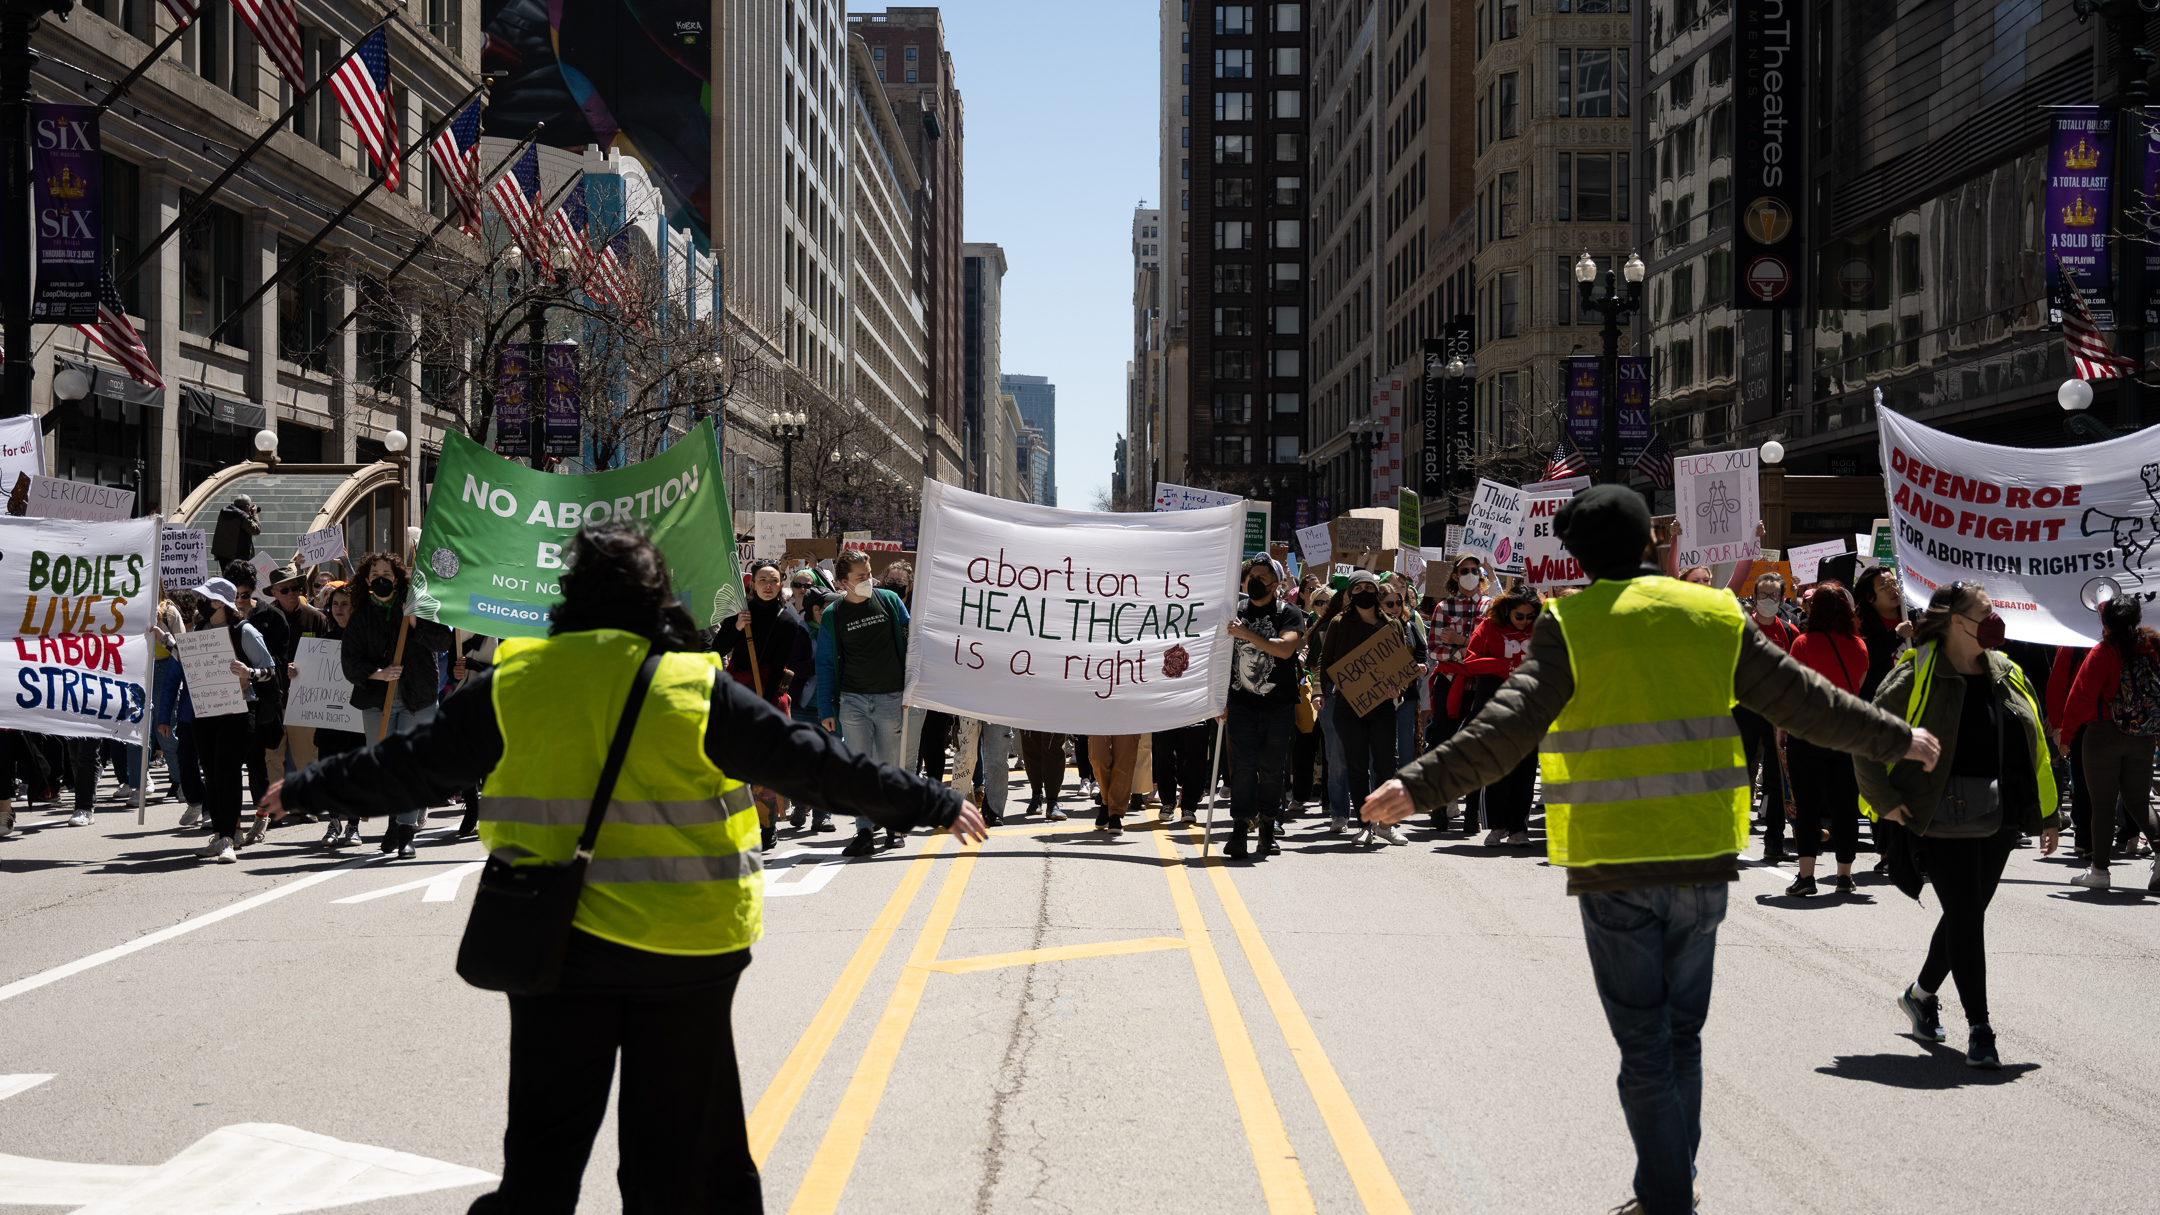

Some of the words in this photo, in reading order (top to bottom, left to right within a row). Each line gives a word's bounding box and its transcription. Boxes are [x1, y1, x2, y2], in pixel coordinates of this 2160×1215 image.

[676, 20, 703, 31] KOBRA
[2059, 176, 2080, 188] TOTAL
[2060, 233, 2087, 248] SOLID
[2074, 256, 2095, 265] PLAYING
[42, 290, 92, 299] LoopChicago.com
[1747, 324, 1769, 352] BLOCK
[1747, 351, 1769, 376] THIRTY
[1747, 377, 1767, 402] SEVEN
[2, 445, 18, 457] for
[1425, 442, 1440, 483] rack
[1680, 456, 1717, 477] FUCK
[1725, 451, 1751, 470] YOU
[1891, 446, 2002, 505] DEFEND
[2005, 484, 2083, 509] ROE
[38, 480, 131, 508] SERIOUSLY?
[461, 473, 518, 518] NO
[525, 464, 699, 529] ABORTION
[1163, 489, 1179, 499] I'm
[1182, 491, 1210, 504] tired
[1216, 497, 1229, 506] of
[1481, 483, 1520, 512] Think
[30, 502, 52, 517] MY
[55, 505, 86, 520] MOM
[1471, 503, 1512, 525] Outside
[1893, 483, 1955, 529] AND
[1957, 511, 2066, 542] FIGHT
[190, 531, 201, 540] the
[1304, 530, 1325, 541] Men
[1467, 517, 1479, 526] of
[1479, 521, 1492, 536] my
[1534, 522, 1549, 538] BE
[1463, 528, 1497, 550] Box!
[1899, 518, 1925, 551] FOR
[1926, 541, 2022, 576] ABORTION
[2028, 549, 2116, 576] RIGHTS!
[160, 552, 189, 562] Enemy
[190, 550, 199, 562] of
[307, 547, 325, 561] TOO
[1678, 550, 1700, 568] AND
[1703, 544, 1732, 564] YOUR
[1734, 540, 1761, 559] LAWS
[28, 550, 144, 597] BODIES
[161, 564, 198, 575] Women!
[967, 547, 1143, 597] abortion
[1164, 571, 1191, 599] is
[1906, 564, 1923, 583] PARTY
[180, 576, 205, 586] Back!
[492, 574, 529, 592] NOT
[18, 595, 128, 636] LIVES
[476, 601, 540, 622] CHICAGO
[959, 586, 1205, 645] HEALTHCARE
[12, 632, 125, 675] LABOR
[308, 640, 331, 654] WE
[954, 634, 985, 670] is
[1009, 649, 1036, 676] a
[1063, 649, 1149, 699] right
[1336, 631, 1402, 690] ABORTION
[1369, 666, 1386, 683] IS
[290, 685, 333, 706] ABORTION
[1350, 660, 1421, 715] HEALTHCARE
[300, 710, 324, 721] HUMAN
[326, 712, 351, 723] RIGHTS
